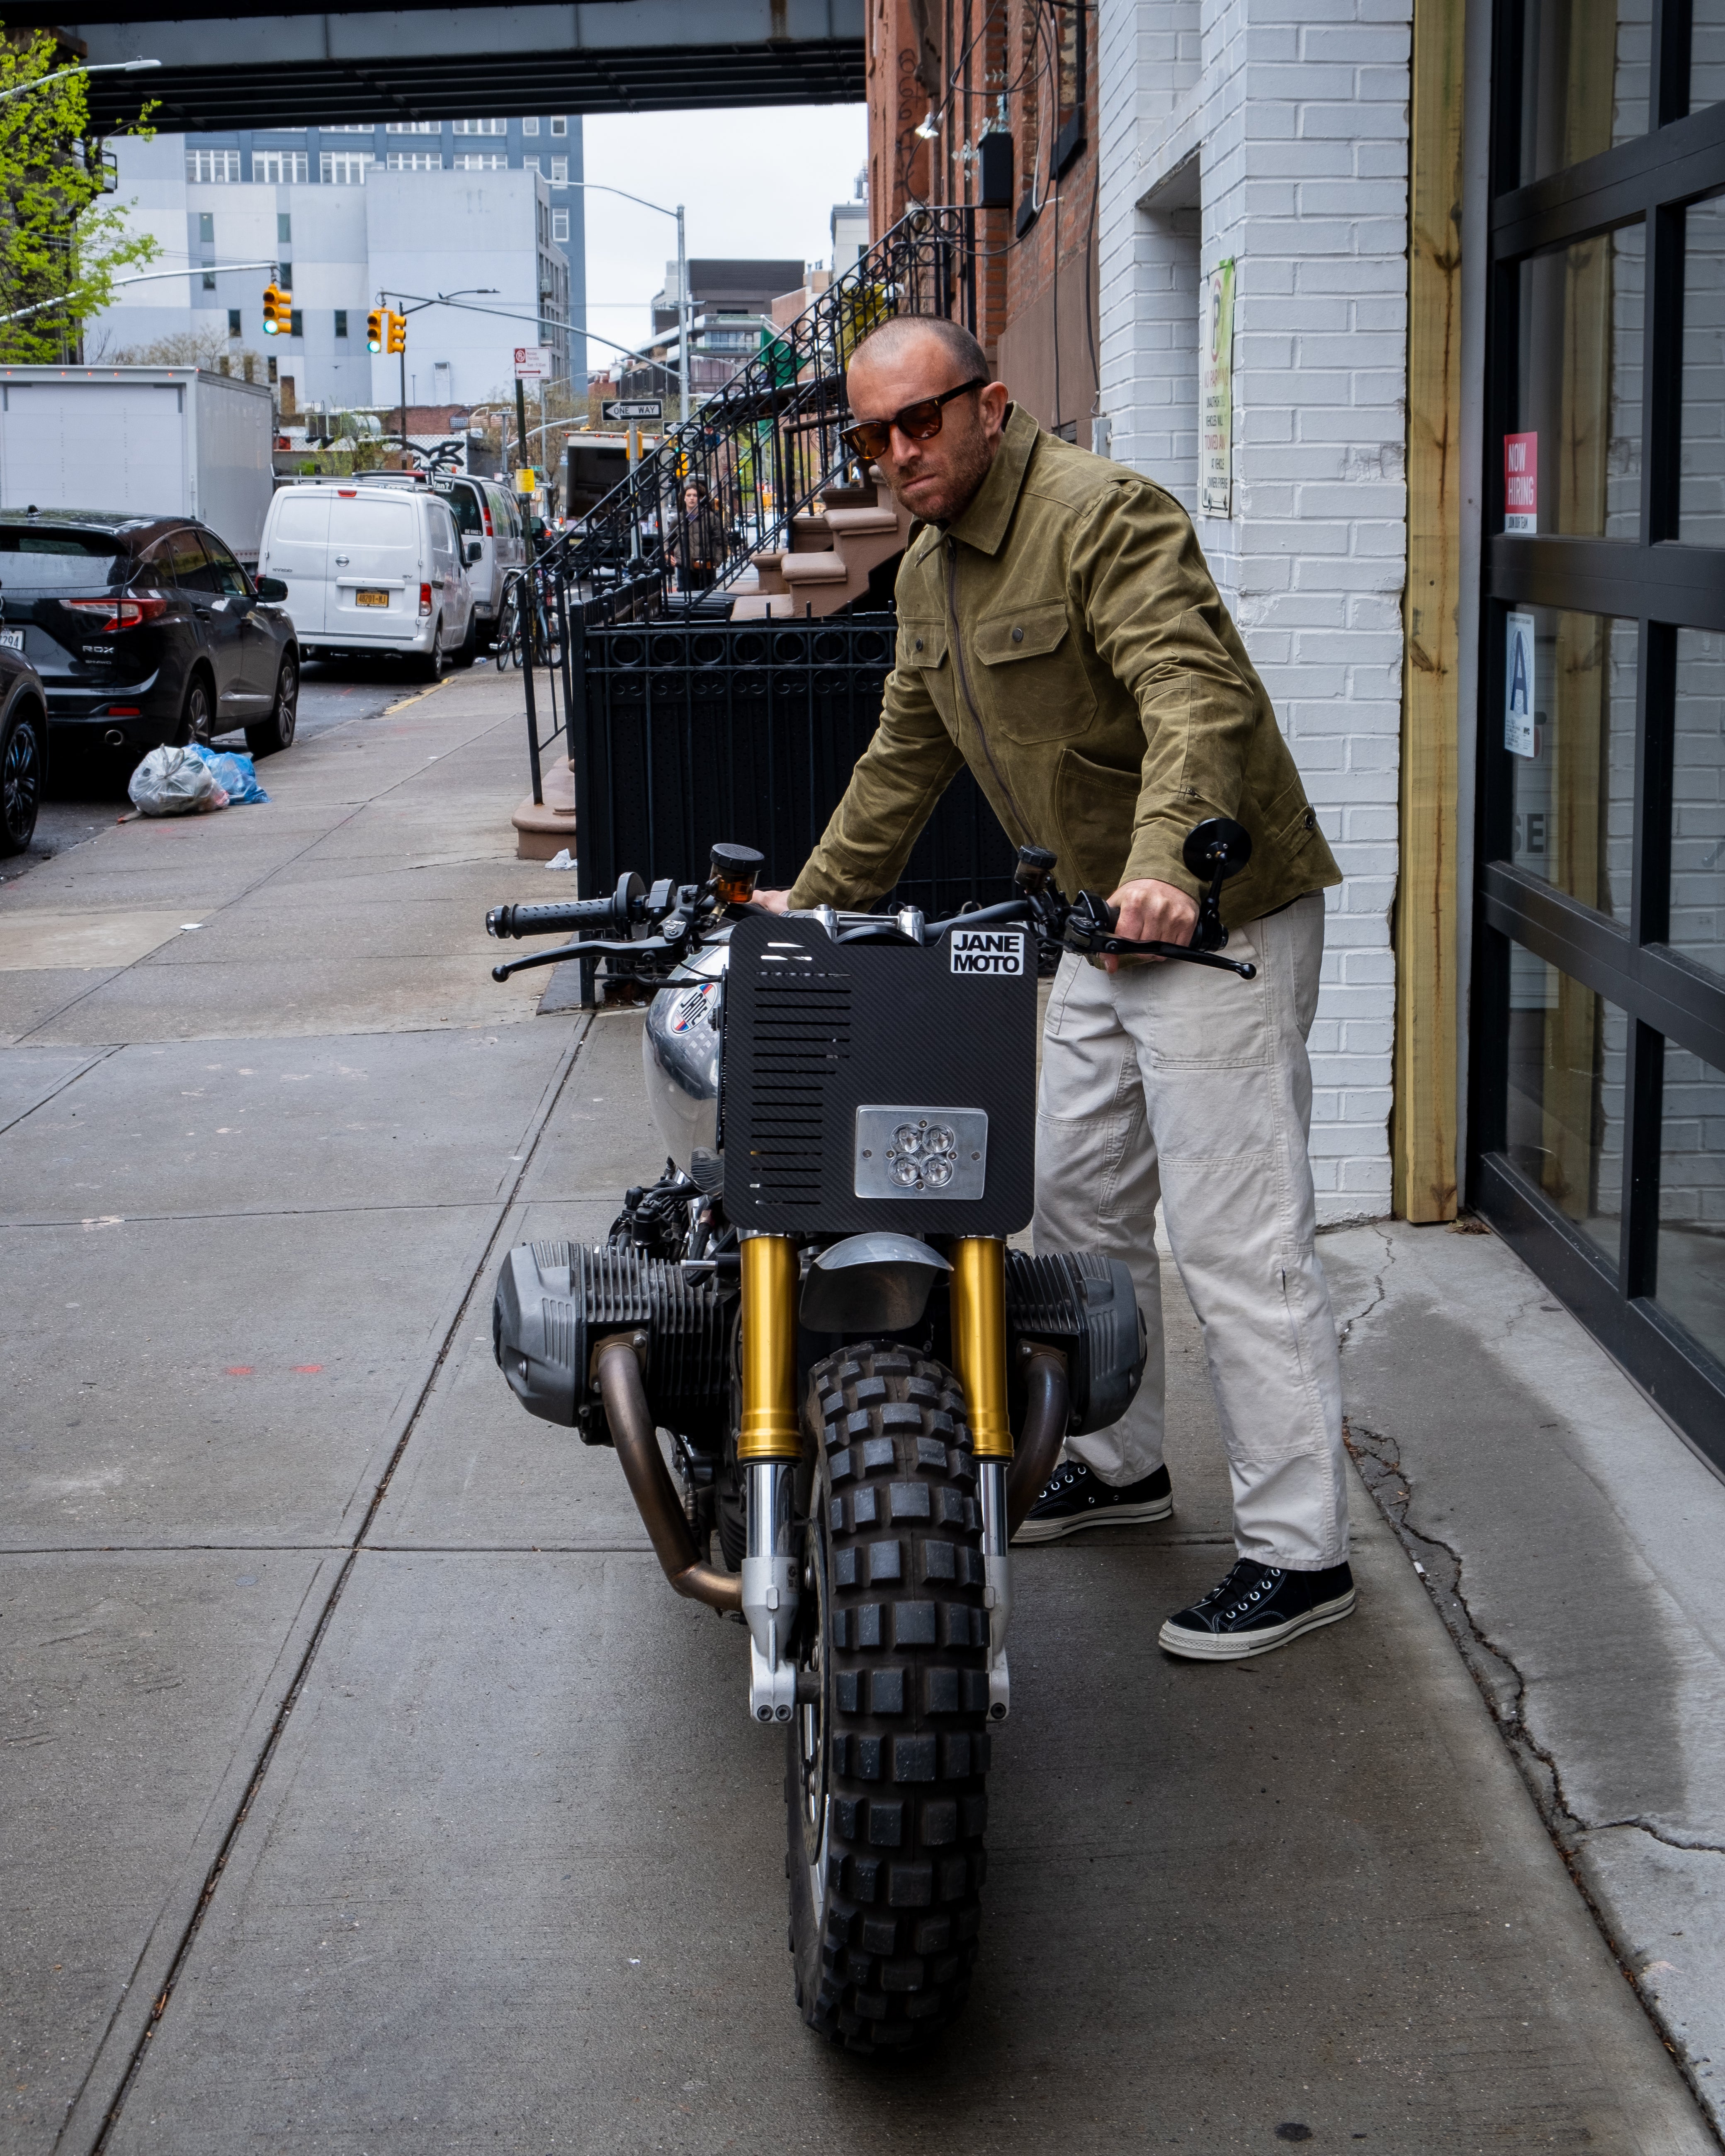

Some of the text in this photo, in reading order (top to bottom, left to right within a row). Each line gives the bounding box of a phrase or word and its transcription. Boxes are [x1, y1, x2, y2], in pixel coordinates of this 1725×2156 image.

[1509, 442, 1526, 472] NOW
[1508, 476, 1533, 505] HIRING
[1510, 631, 1528, 714] A
[953, 934, 1020, 953] JANE
[954, 954, 1020, 973] MOTO
[680, 992, 708, 1026] JANE
